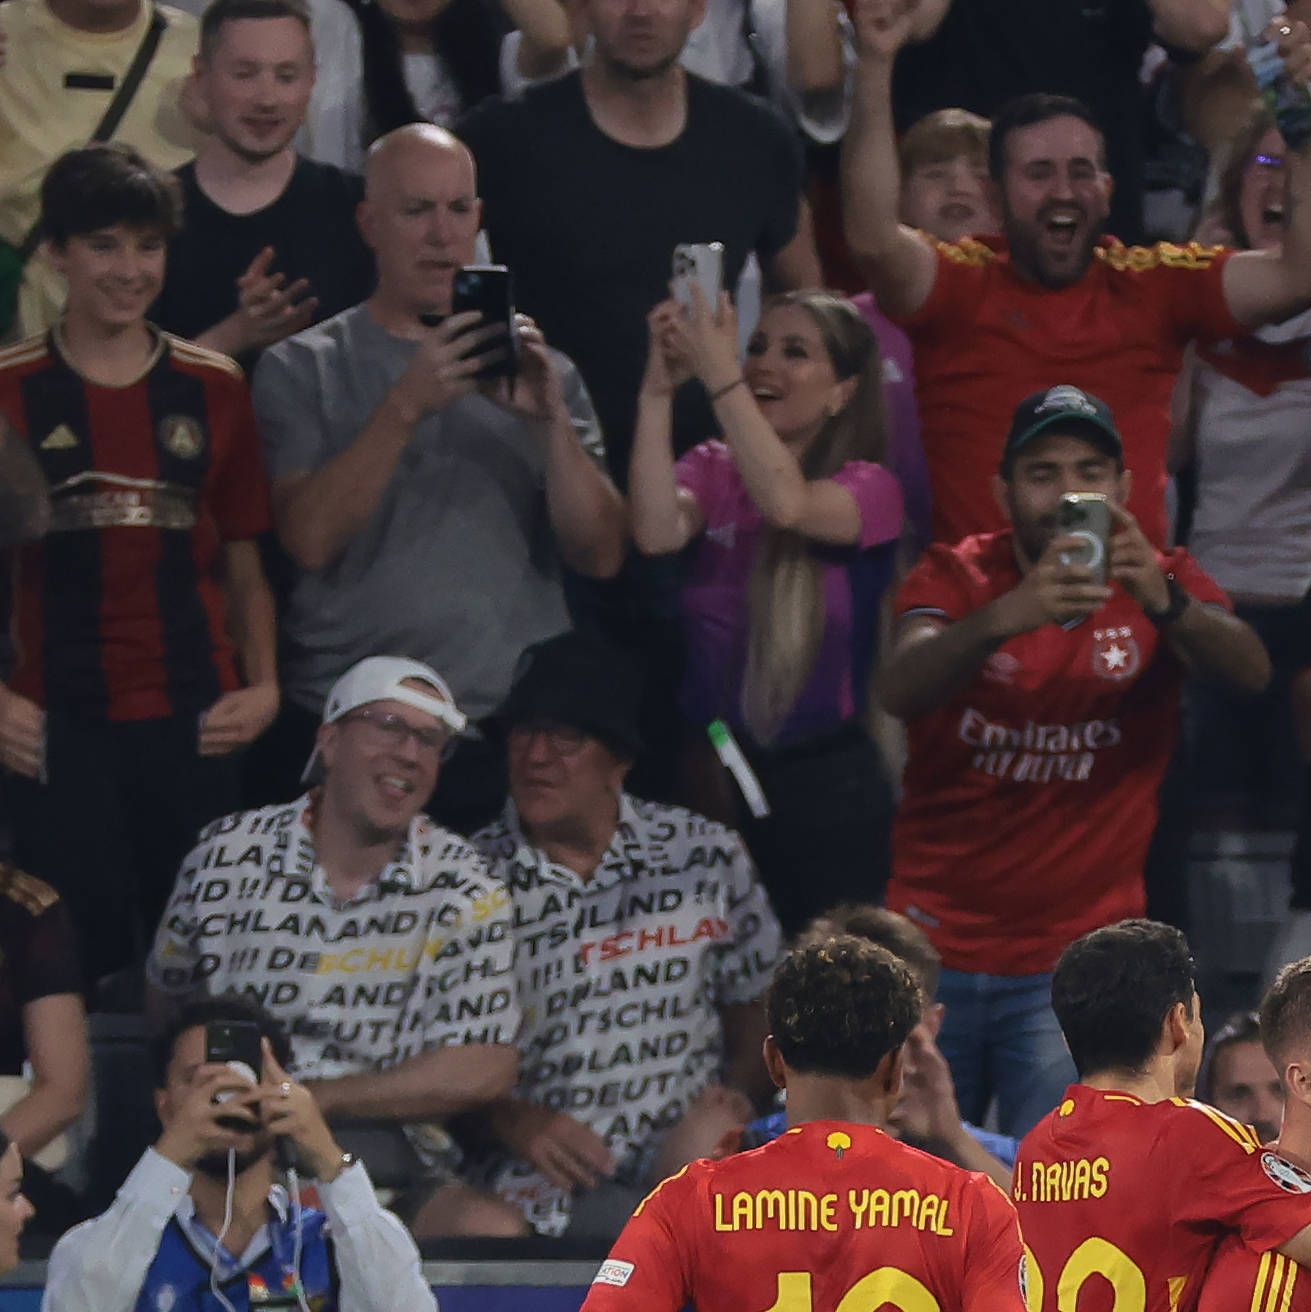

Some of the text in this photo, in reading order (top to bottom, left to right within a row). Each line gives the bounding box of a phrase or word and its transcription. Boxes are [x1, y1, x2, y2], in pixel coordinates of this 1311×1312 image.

[1031, 1156, 1111, 1202] NAVAS
[715, 1188, 954, 1237] LAMINE YAMAL
